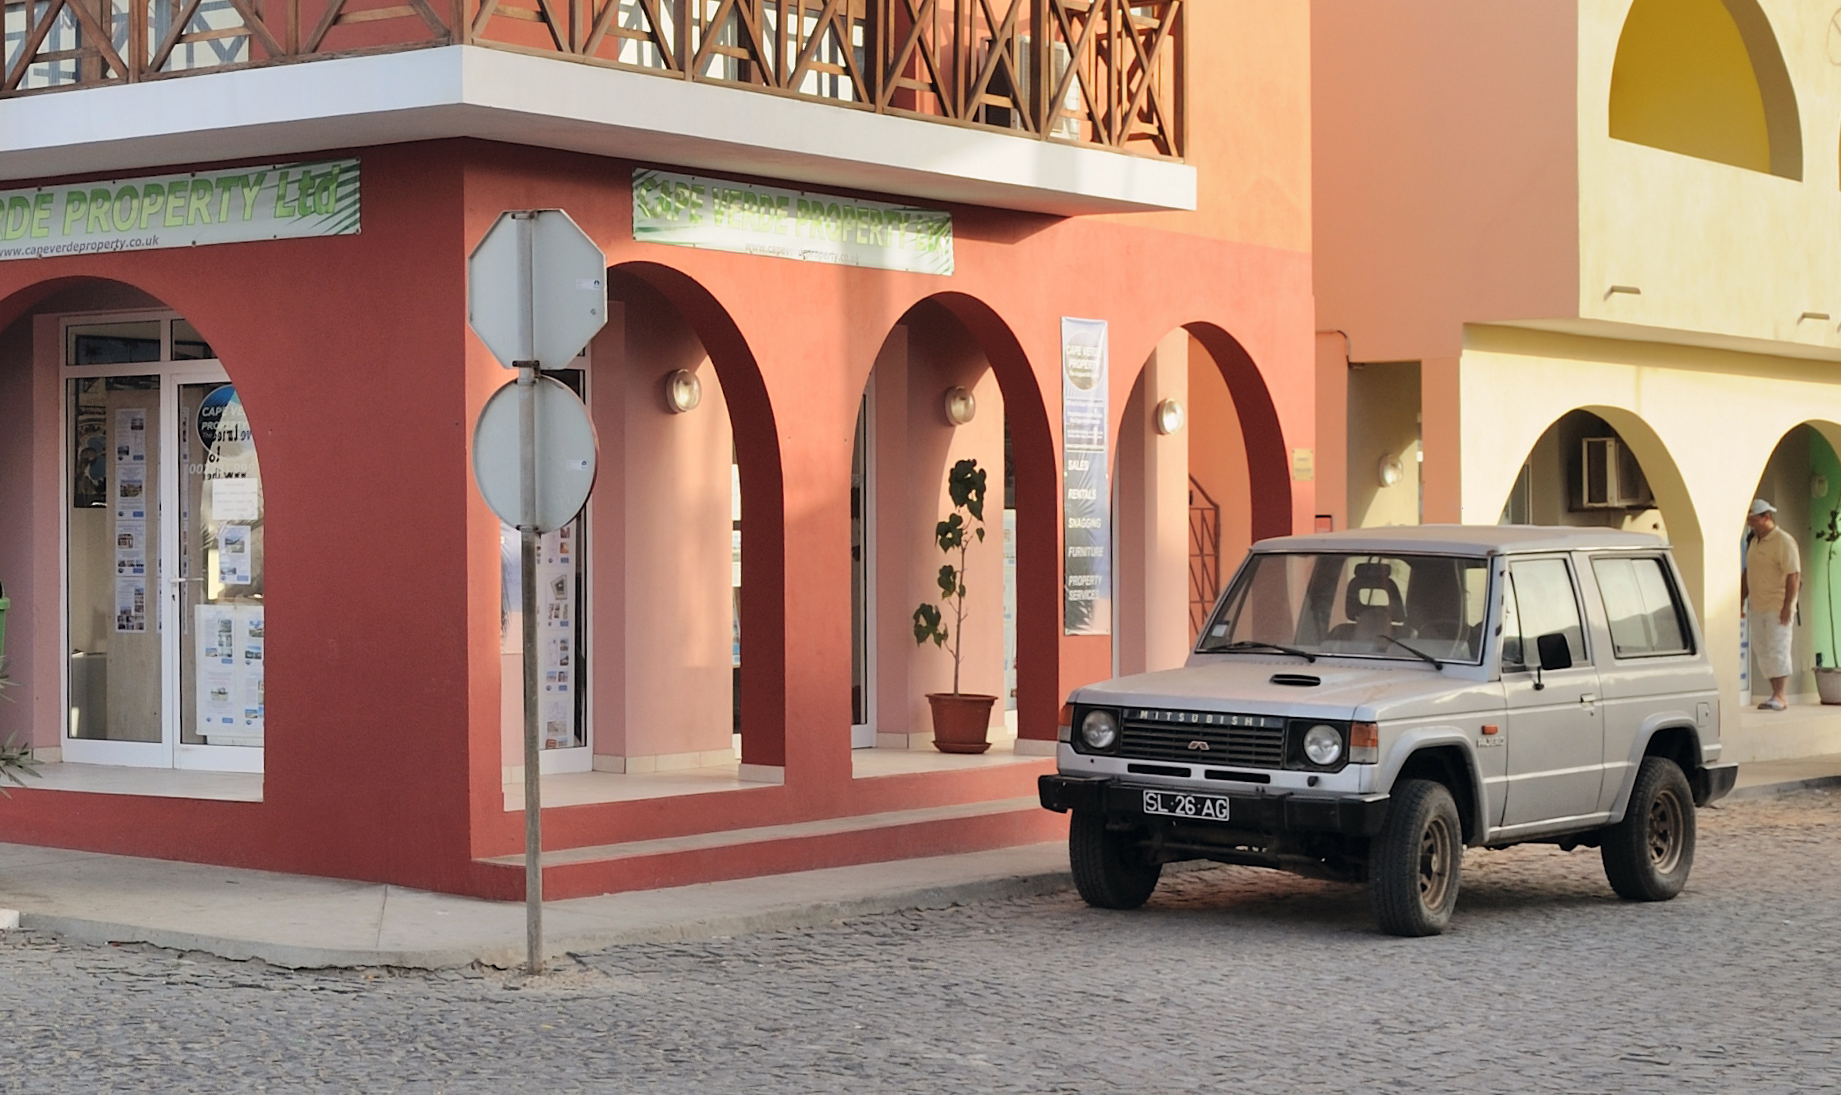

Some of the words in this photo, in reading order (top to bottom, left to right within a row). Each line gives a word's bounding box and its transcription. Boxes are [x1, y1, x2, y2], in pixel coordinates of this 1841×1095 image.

[62, 172, 268, 236] PROPERTY
[274, 164, 342, 219] Ltd
[637, 177, 705, 224] CAPE
[712, 186, 790, 235] VERDE
[796, 198, 911, 250] PROPERTY
[1068, 459, 1089, 471] SALES
[1068, 488, 1097, 500] RENTALS
[1068, 517, 1101, 529] SNAGGING
[1068, 546, 1104, 558] FURNITURE
[1068, 574, 1102, 586] PROPERTY
[1068, 590, 1100, 601] SERVICES
[1139, 710, 1265, 727] MITSUBISHI
